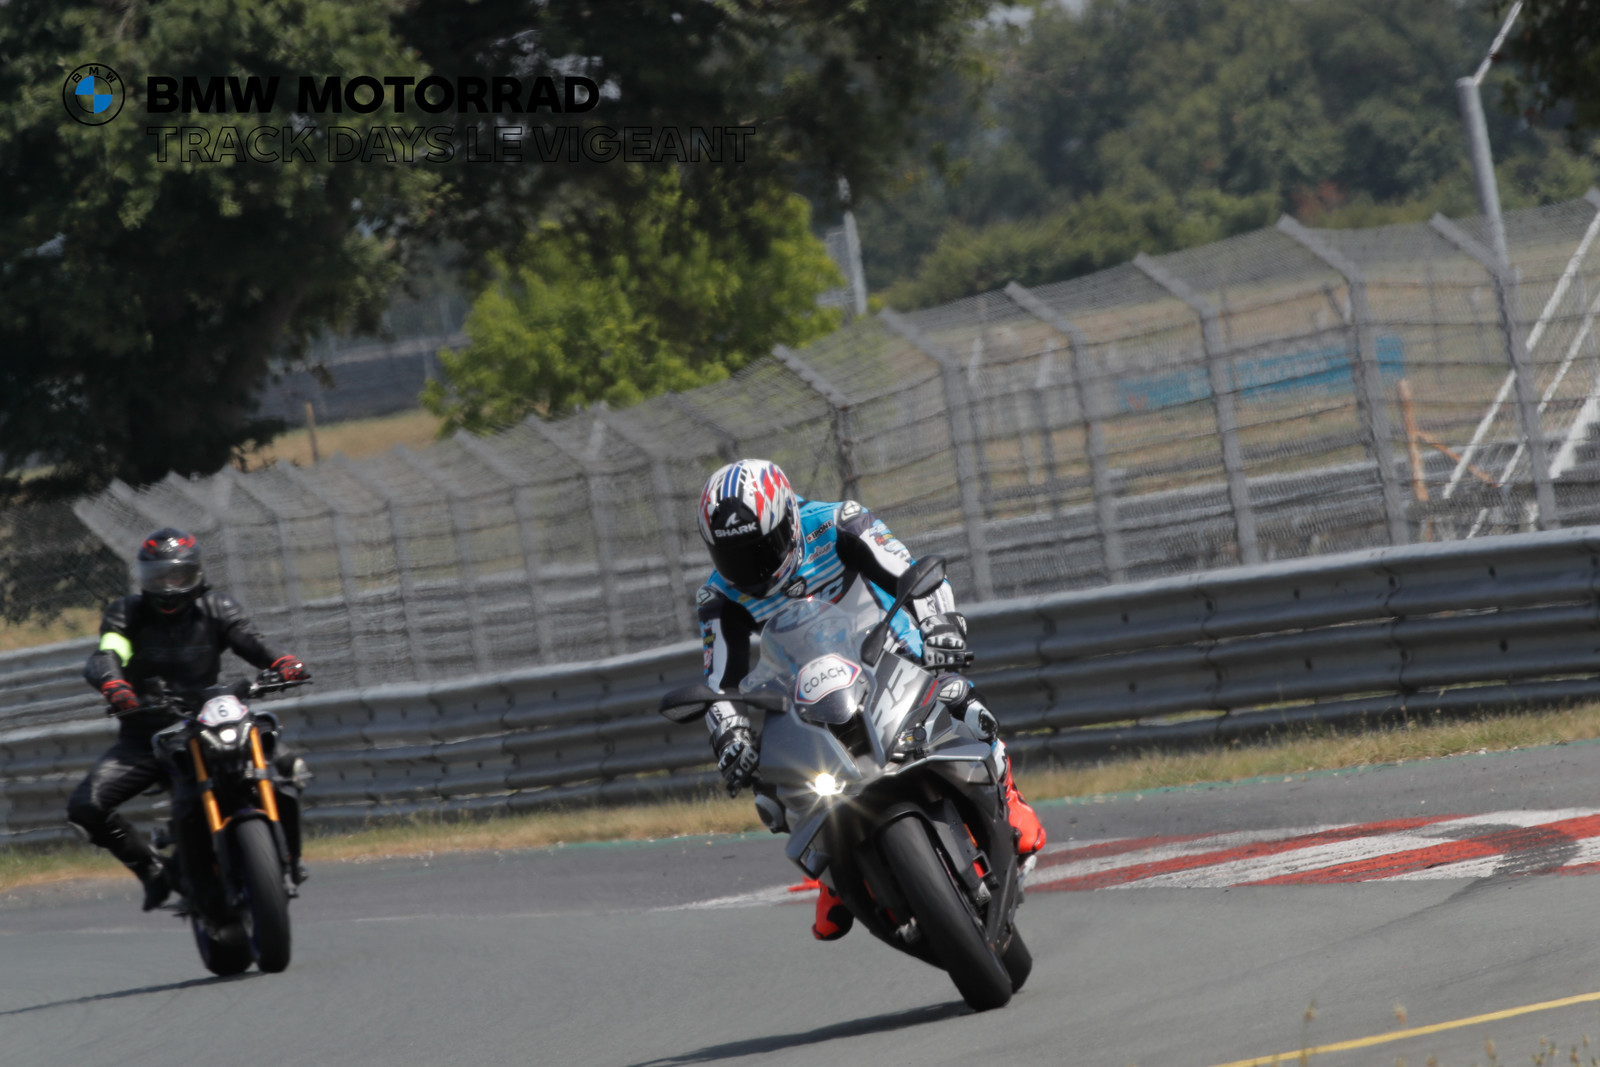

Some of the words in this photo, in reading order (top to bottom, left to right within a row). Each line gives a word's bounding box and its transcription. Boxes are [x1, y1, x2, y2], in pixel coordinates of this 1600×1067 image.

[714, 522, 758, 538] SHARK
[803, 666, 848, 694] COACH
[218, 704, 229, 718] 6
